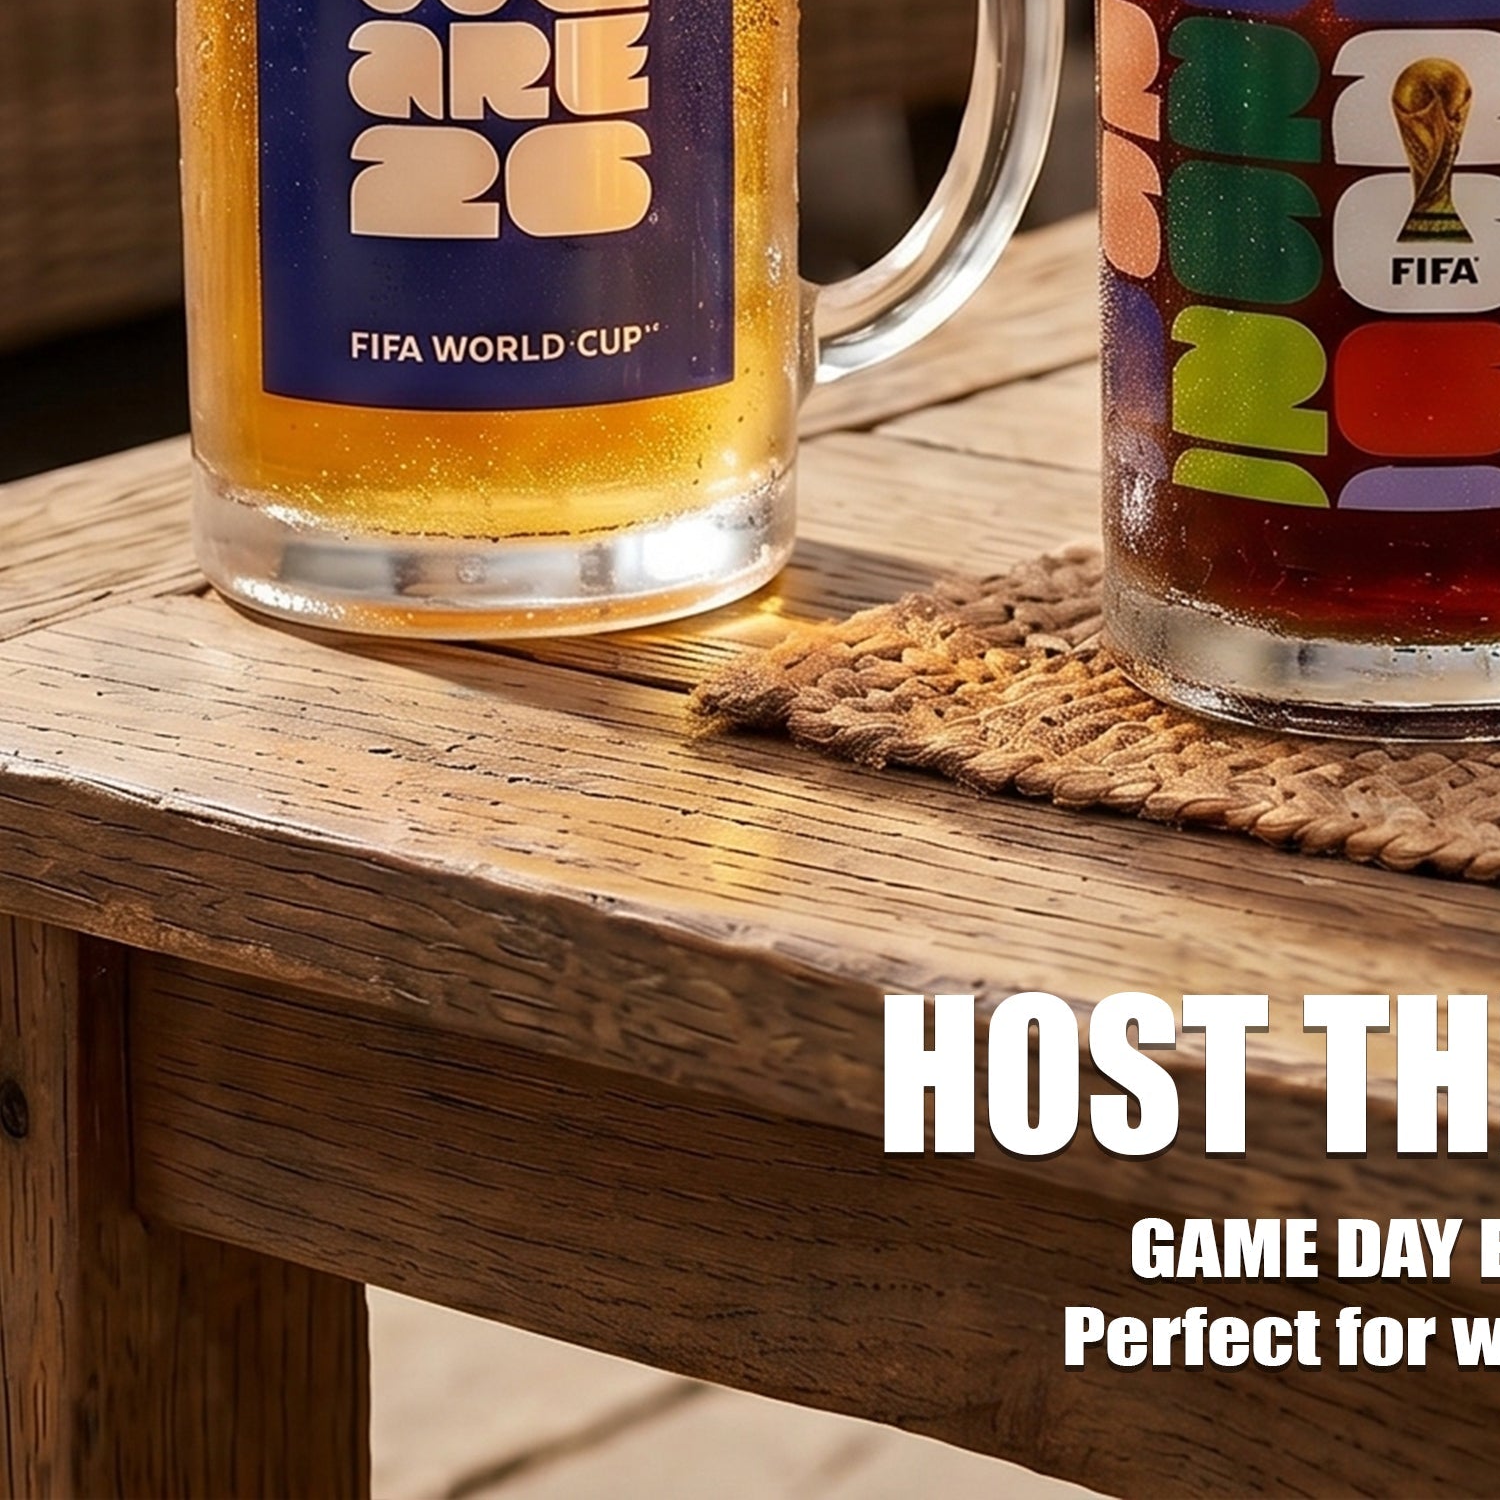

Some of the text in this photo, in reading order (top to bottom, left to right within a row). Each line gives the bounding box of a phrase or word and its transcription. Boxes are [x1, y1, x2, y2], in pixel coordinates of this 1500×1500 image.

[350, 120, 652, 239] 26
[1391, 257, 1479, 285] FIFA
[351, 331, 424, 362] FIFA
[432, 333, 565, 363] WORLD
